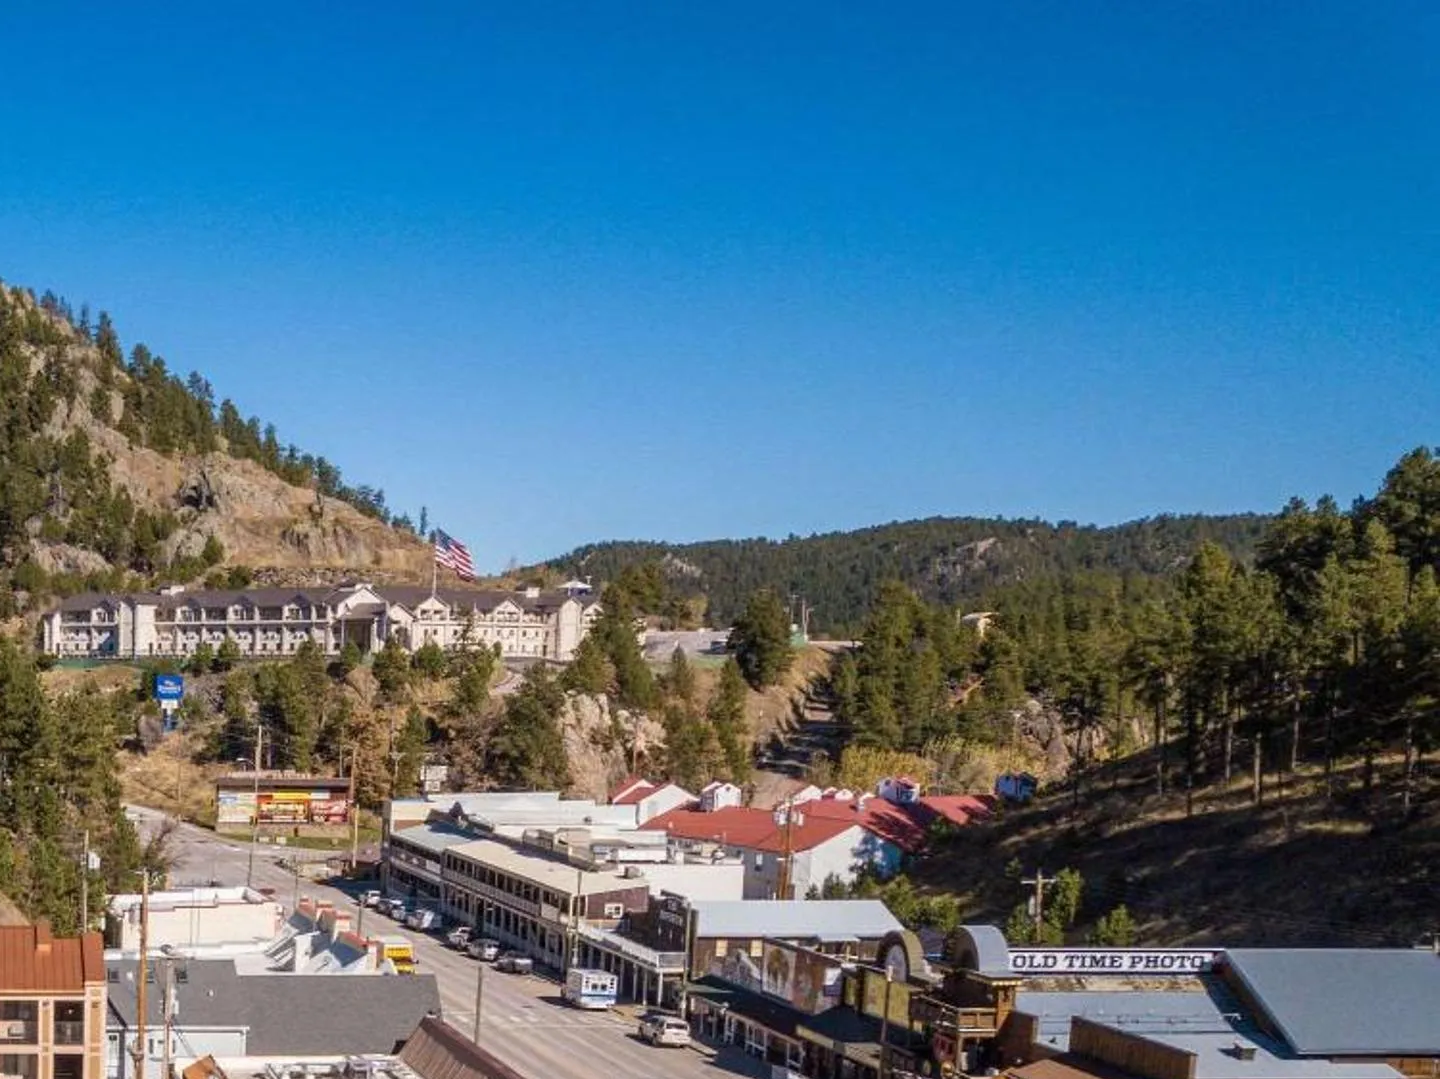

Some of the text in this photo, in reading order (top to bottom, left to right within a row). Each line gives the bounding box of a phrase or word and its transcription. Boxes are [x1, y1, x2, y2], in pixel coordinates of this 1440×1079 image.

[1012, 955, 1205, 969] OLD TIME PHOTO
